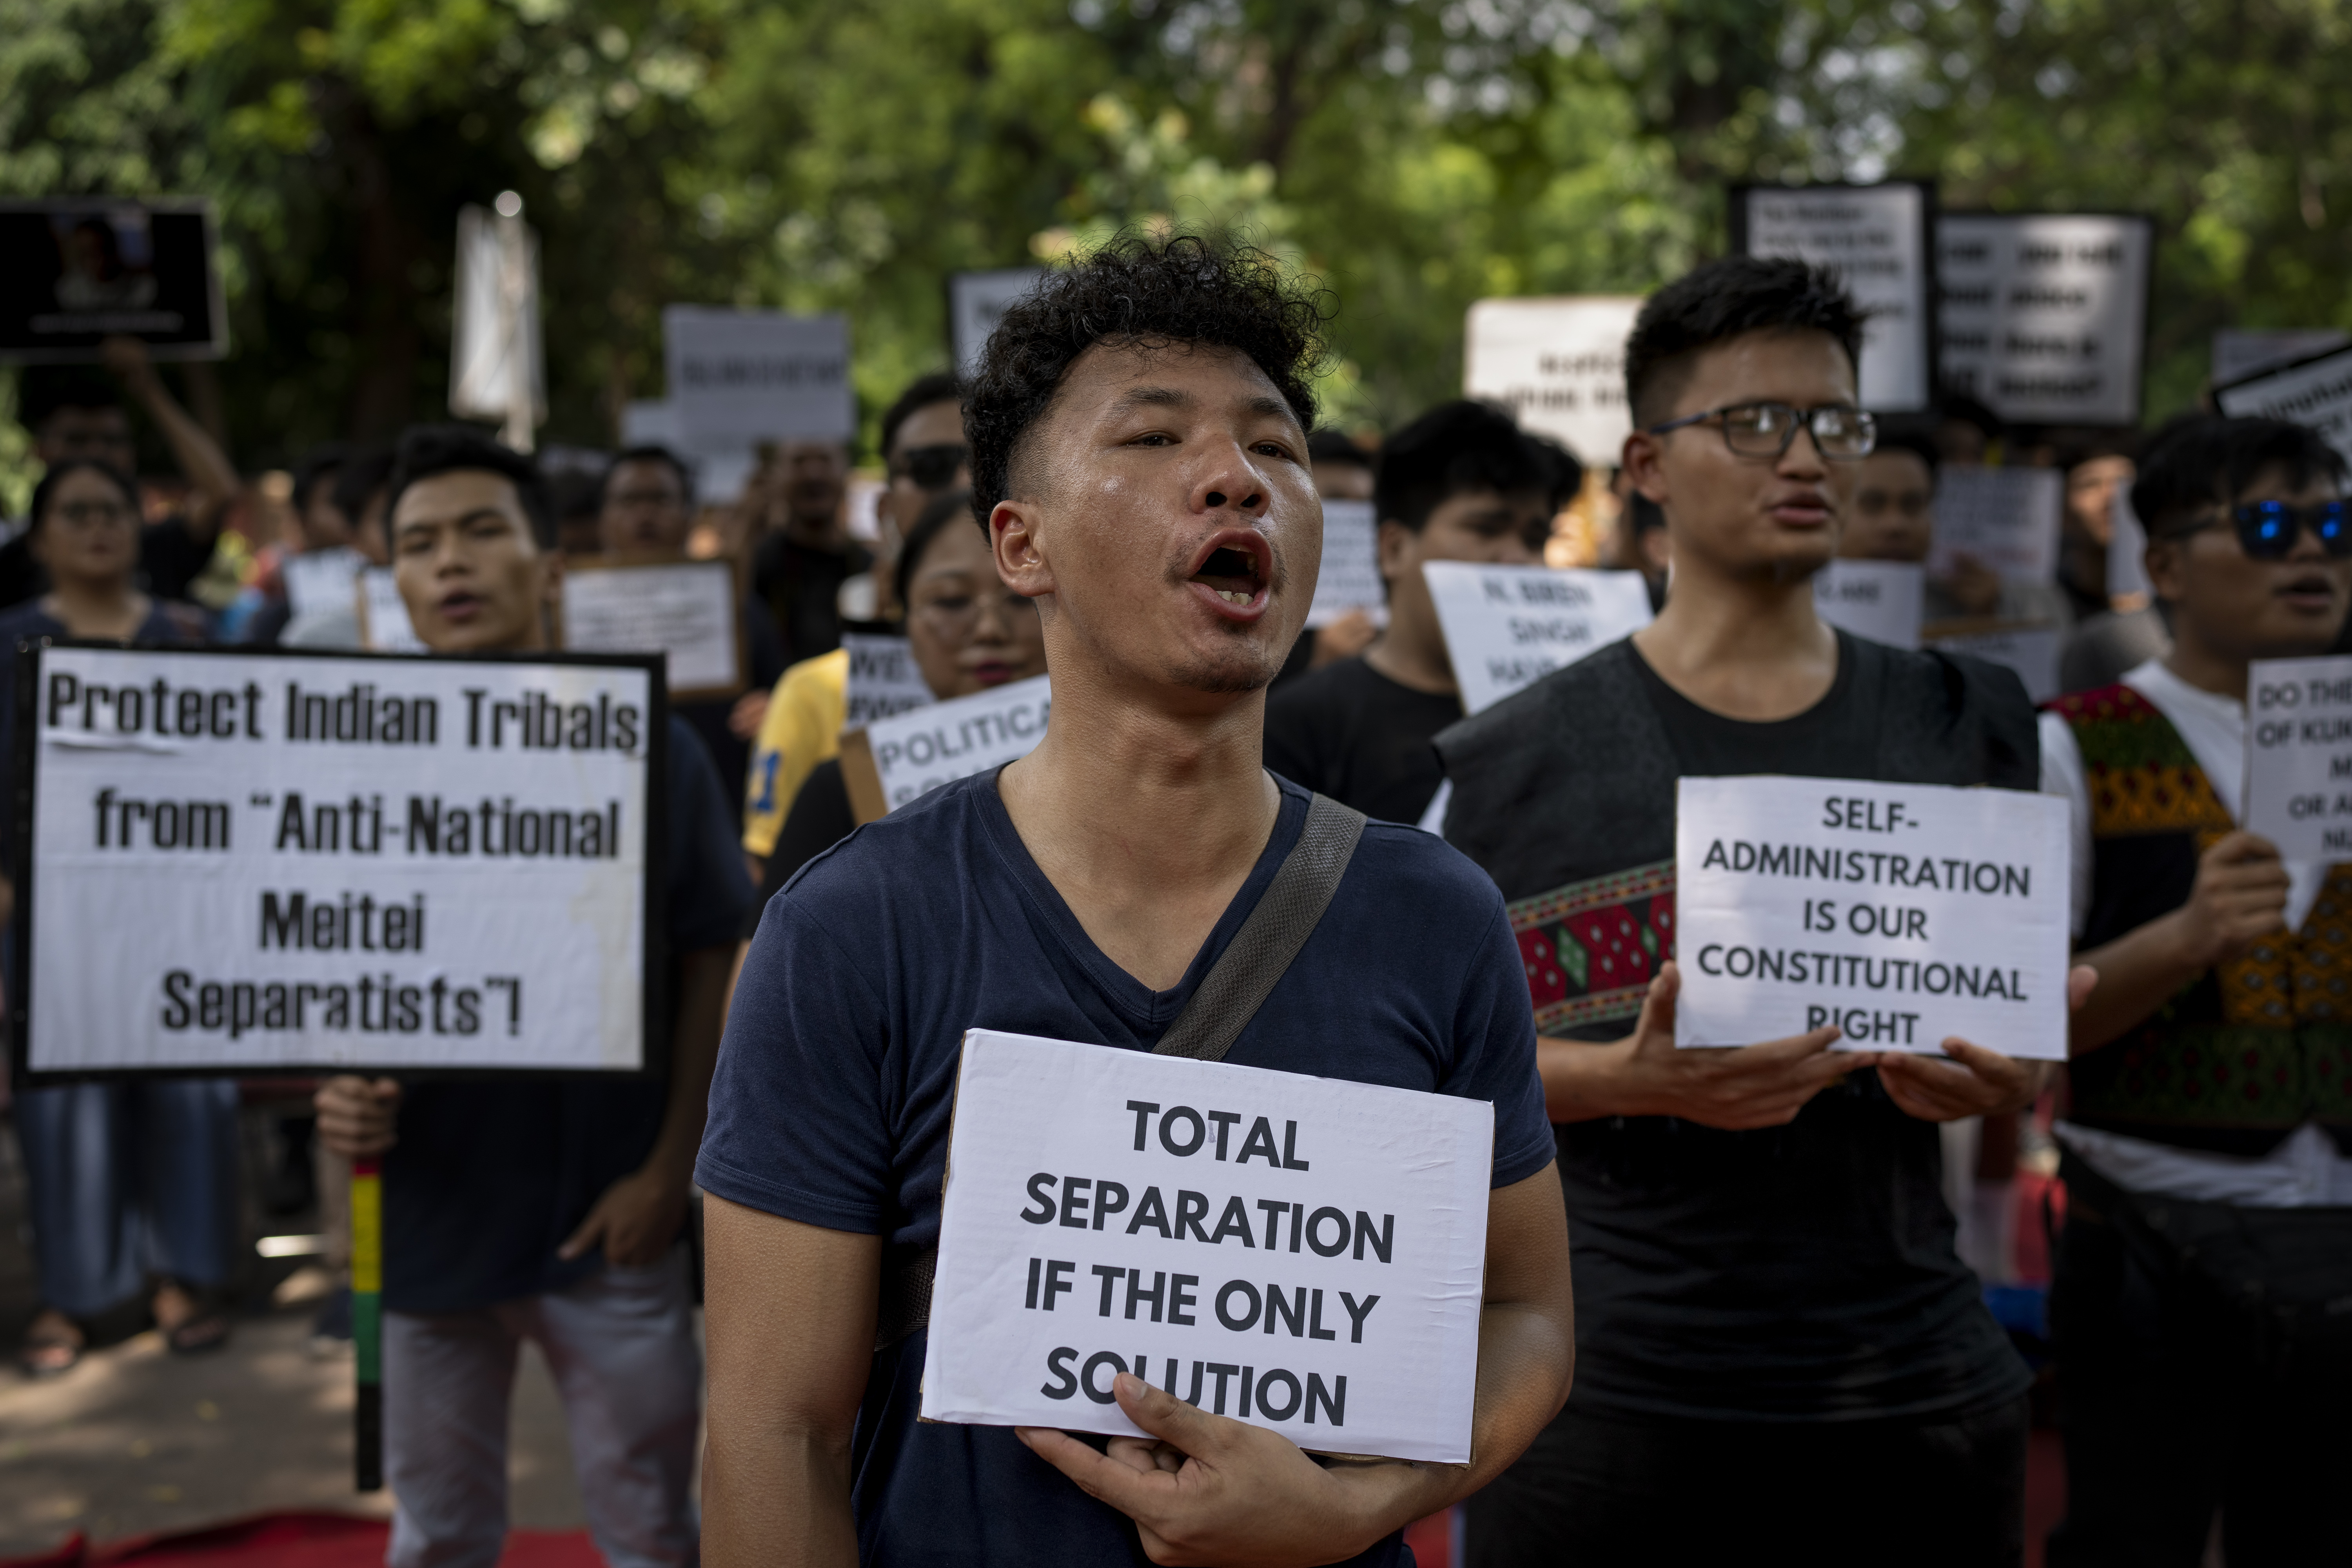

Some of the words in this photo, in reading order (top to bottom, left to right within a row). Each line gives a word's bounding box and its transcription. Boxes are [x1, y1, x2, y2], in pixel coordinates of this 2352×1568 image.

[1486, 657, 1559, 685] HAV
[2258, 682, 2301, 710] DO
[47, 672, 263, 740] Protect
[286, 680, 437, 745] Indian
[463, 688, 641, 751] Tribals
[2256, 721, 2293, 747] OF
[93, 787, 231, 849] from
[250, 791, 621, 858] “Anti-National
[1822, 796, 1919, 832] SELF-
[1703, 839, 2030, 897] ADMINISTRATION
[259, 890, 426, 952] Meitei
[1804, 899, 1837, 932] IS
[1847, 903, 1929, 940] OUR
[1698, 944, 2028, 1001] CONSTITUTIONAL
[162, 971, 522, 1040] Separatists”!
[1807, 1005, 1920, 1044] RIGHT
[1126, 1100, 1309, 1171] TOTAL
[1021, 1172, 1394, 1263] SEPARATION
[1025, 1258, 1073, 1311] IF
[1092, 1265, 1199, 1326] THE
[1215, 1279, 1380, 1343] ONLY
